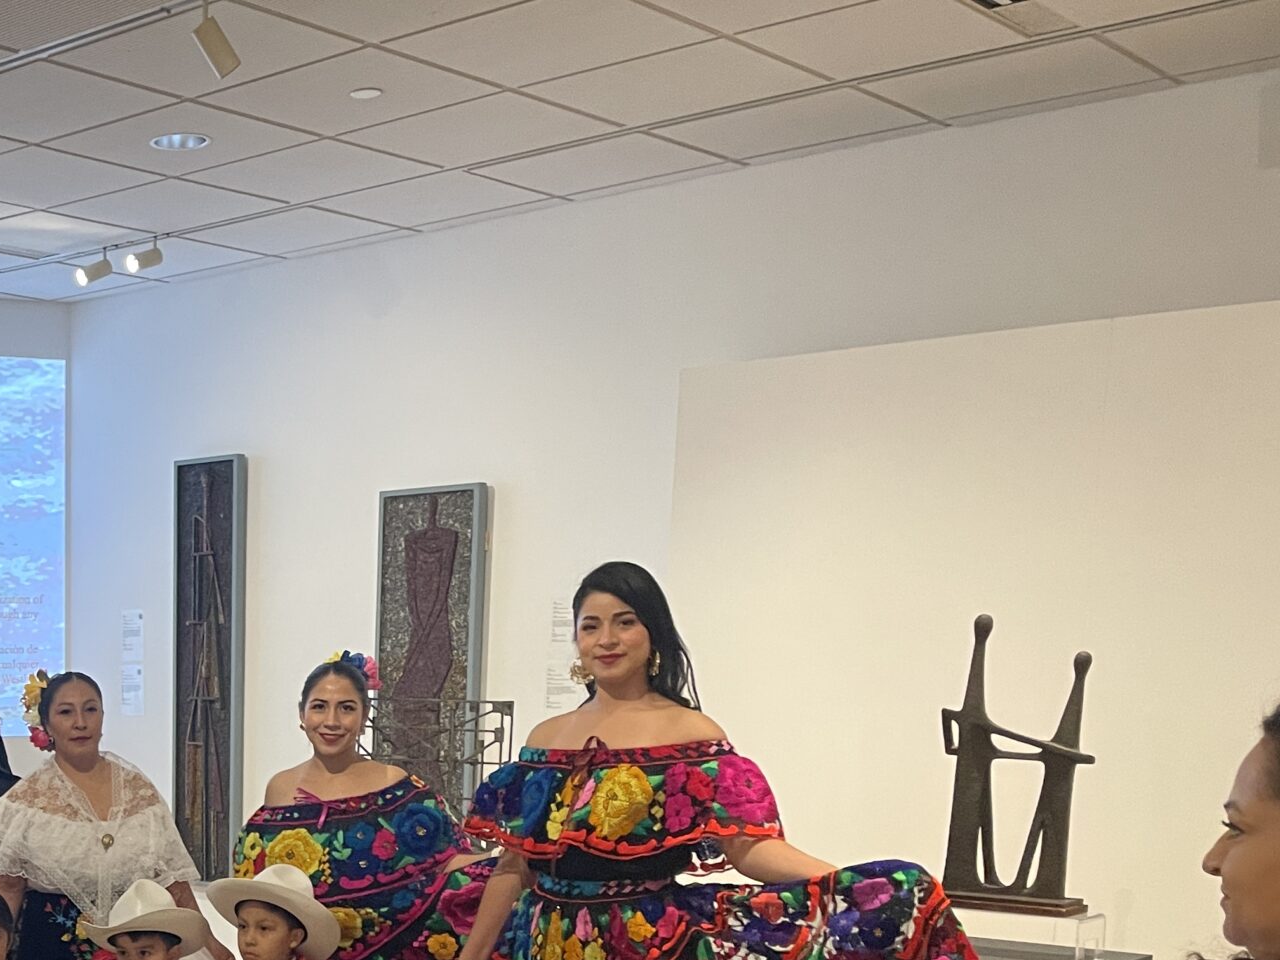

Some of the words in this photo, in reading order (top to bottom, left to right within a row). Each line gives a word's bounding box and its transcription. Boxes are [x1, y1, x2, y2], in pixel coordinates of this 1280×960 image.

[33, 594, 44, 604] of
[22, 611, 39, 621] any
[27, 646, 39, 654] de
